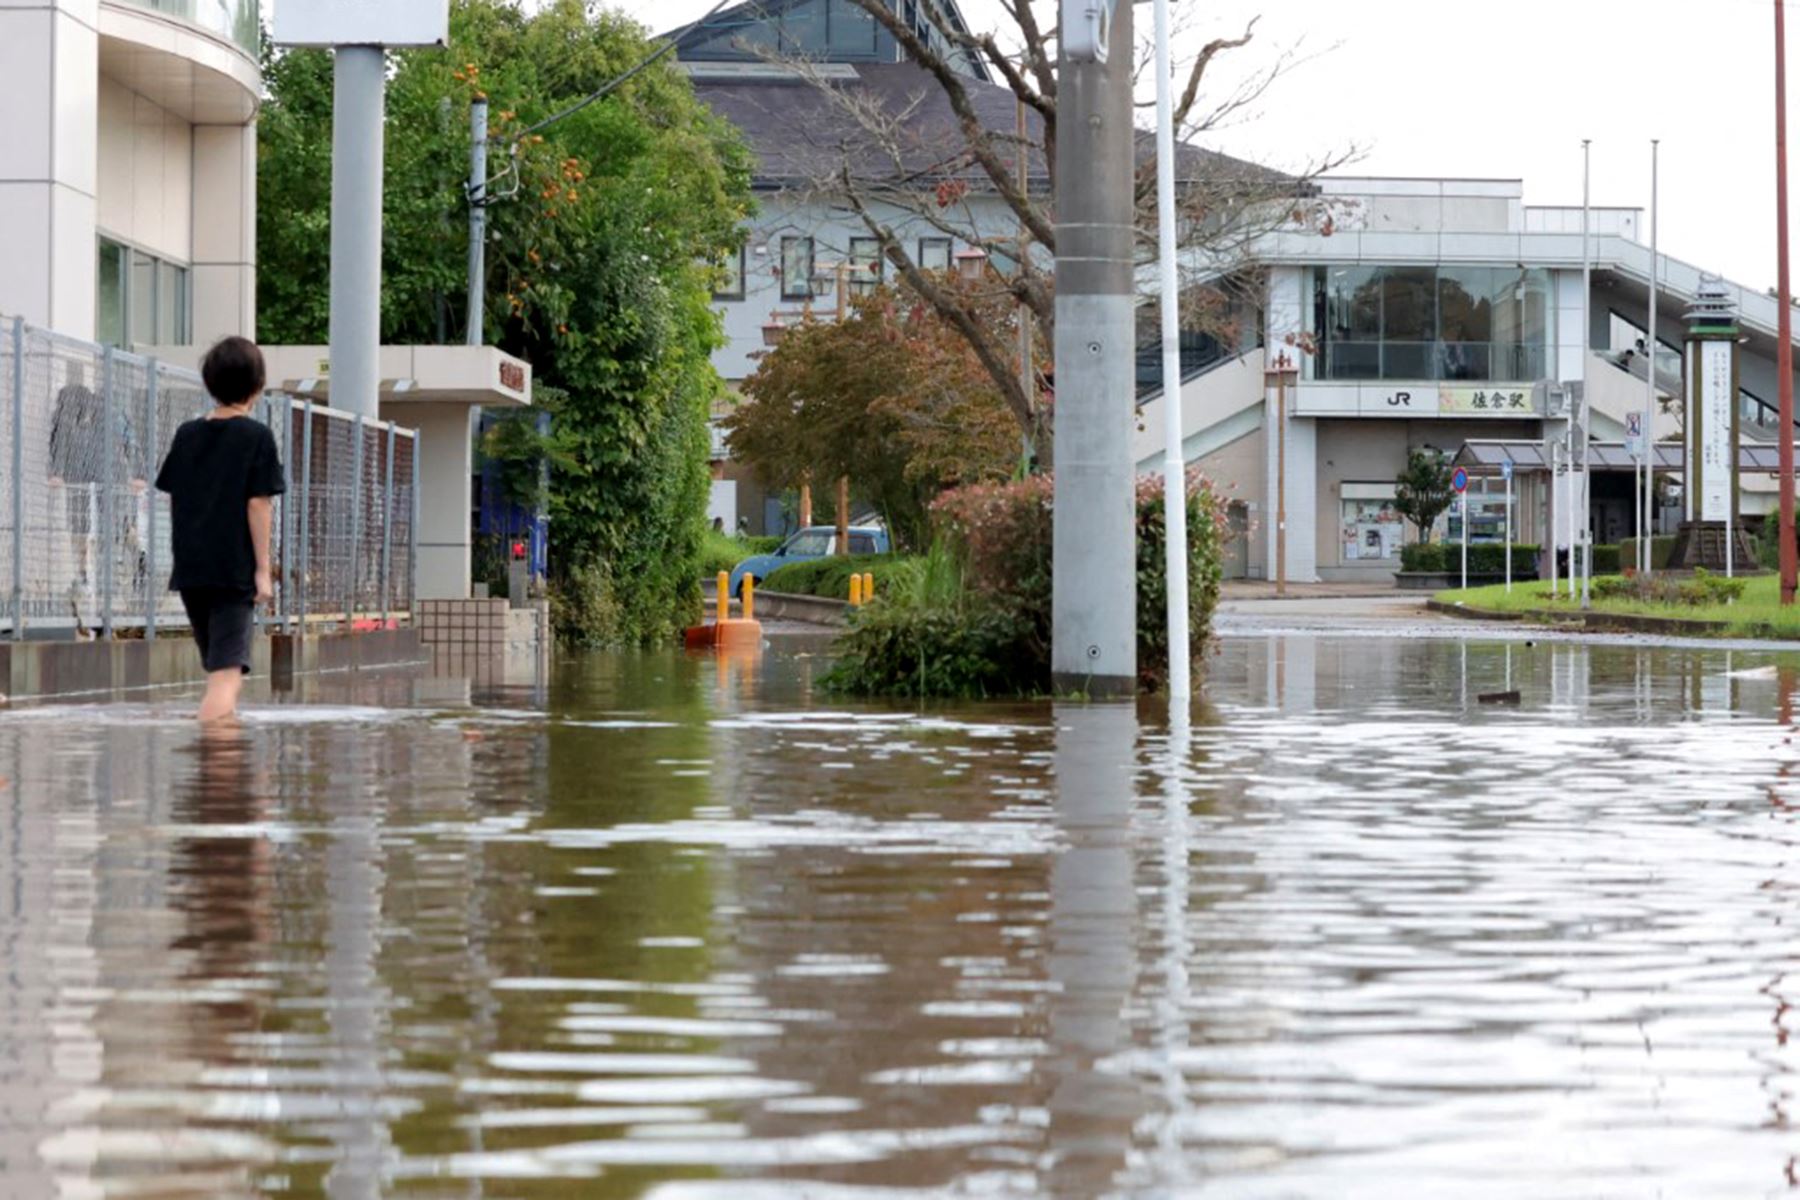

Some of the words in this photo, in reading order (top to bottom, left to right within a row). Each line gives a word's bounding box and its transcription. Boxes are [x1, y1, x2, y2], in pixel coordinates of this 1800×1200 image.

[1387, 392, 1411, 406] JR
[1471, 391, 1525, 409] 佐倉駅
